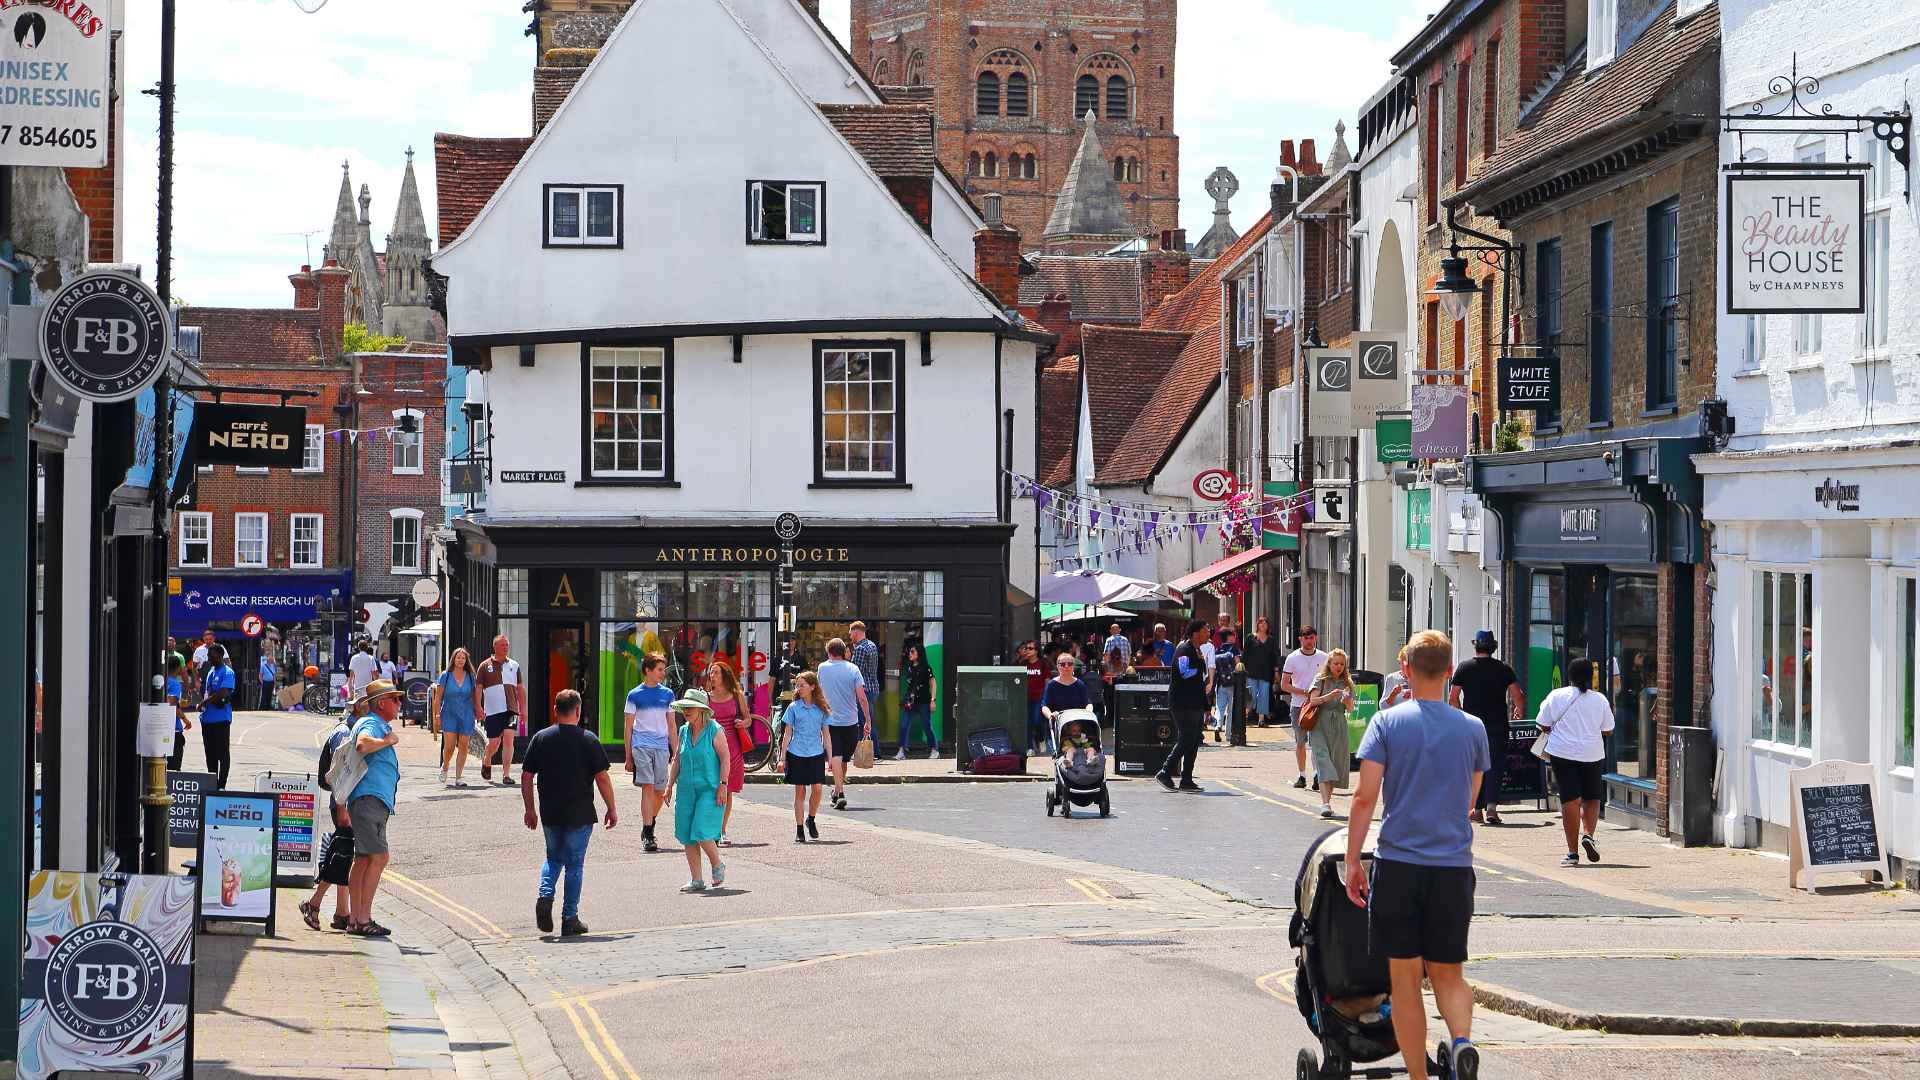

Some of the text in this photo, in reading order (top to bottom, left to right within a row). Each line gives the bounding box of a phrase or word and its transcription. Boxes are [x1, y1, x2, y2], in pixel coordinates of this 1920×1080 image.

[0, 86, 101, 108] DRESSING
[19, 126, 97, 149] 854605
[1772, 196, 1821, 218] THE
[1741, 210, 1849, 259] Beauty
[1748, 251, 1843, 273] HOUSE
[1749, 280, 1760, 292] by
[52, 280, 160, 330] FARROW & BALL
[72, 316, 138, 355] F&B
[52, 347, 157, 391] PAINT & PAPER
[1509, 367, 1550, 379] WHITE
[1509, 385, 1550, 398] STUFF
[231, 421, 268, 431] CAFFÈ
[209, 432, 289, 450] NERO
[1419, 443, 1459, 455] chesca
[1561, 509, 1596, 532] WHITE STUFF
[656, 548, 849, 561] ANTHROPOOGIE
[207, 595, 248, 605] CANCER
[251, 595, 301, 605] RESEARCH
[550, 573, 578, 606] A
[172, 780, 199, 791] ICED
[272, 782, 308, 791] iRepair
[170, 807, 197, 816] SOFT
[215, 810, 263, 820] NERO
[52, 927, 160, 976] FARROW & BALL
[73, 963, 138, 1000] F&B
[57, 1002, 153, 1037] PAINT & PAPER
